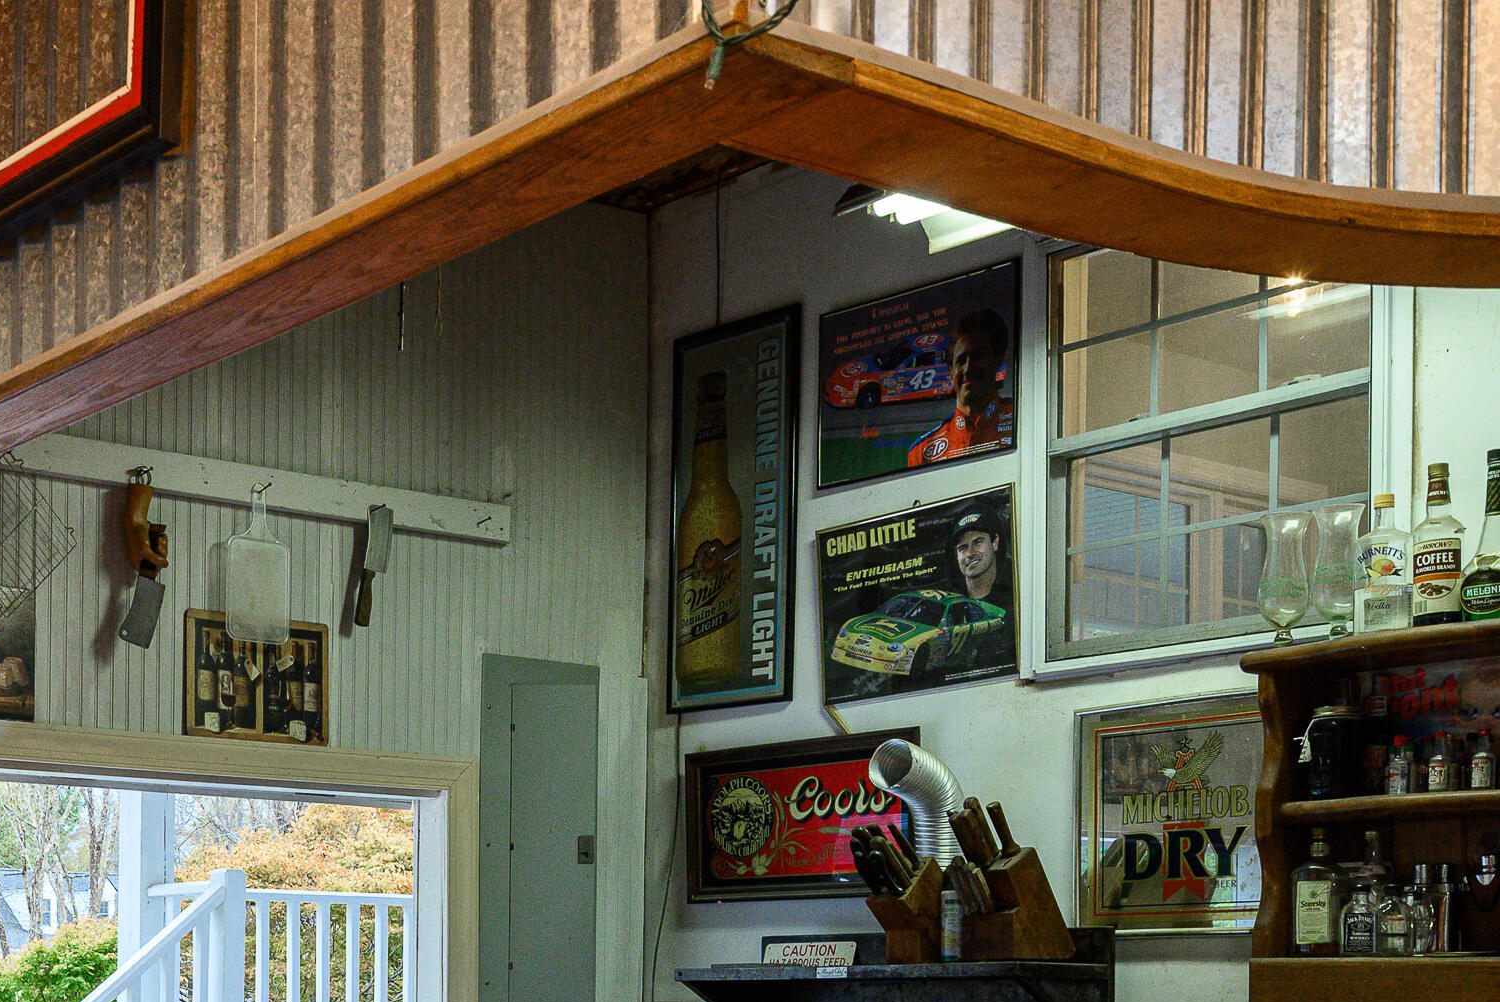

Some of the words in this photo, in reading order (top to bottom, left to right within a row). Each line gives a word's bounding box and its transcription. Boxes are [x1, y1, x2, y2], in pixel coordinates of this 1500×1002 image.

[918, 334, 938, 346] 43
[909, 368, 936, 390] 43
[755, 336, 781, 473] GENUINE
[925, 439, 945, 456] STP
[753, 480, 777, 582] DRAFT
[826, 531, 867, 557] CHAD
[870, 518, 916, 548] LITTLE
[1357, 545, 1406, 566] BURNETT'S
[1416, 551, 1455, 567] COFFEE
[1436, 562, 1456, 572] BRANDY
[845, 556, 924, 582] ENTHUSIASM
[849, 581, 863, 590] Fuel
[864, 578, 879, 587] That
[879, 574, 902, 584] Drives
[902, 571, 914, 579] The
[683, 567, 735, 613] Miller
[681, 605, 717, 630] Genuine
[1366, 601, 1391, 611] Vodka
[694, 613, 725, 636] LIGHT
[751, 591, 775, 680] LIGHT
[712, 777, 744, 815] ADOLPH
[744, 778, 774, 818] COORS
[785, 774, 894, 821] Coors
[1122, 784, 1250, 826] MICHELOB
[1122, 825, 1251, 883] DRY
[1214, 879, 1237, 889] BEER
[769, 957, 820, 967] HAZARDOUS
[823, 957, 846, 967] FEED
[782, 944, 837, 957] CAUTION
